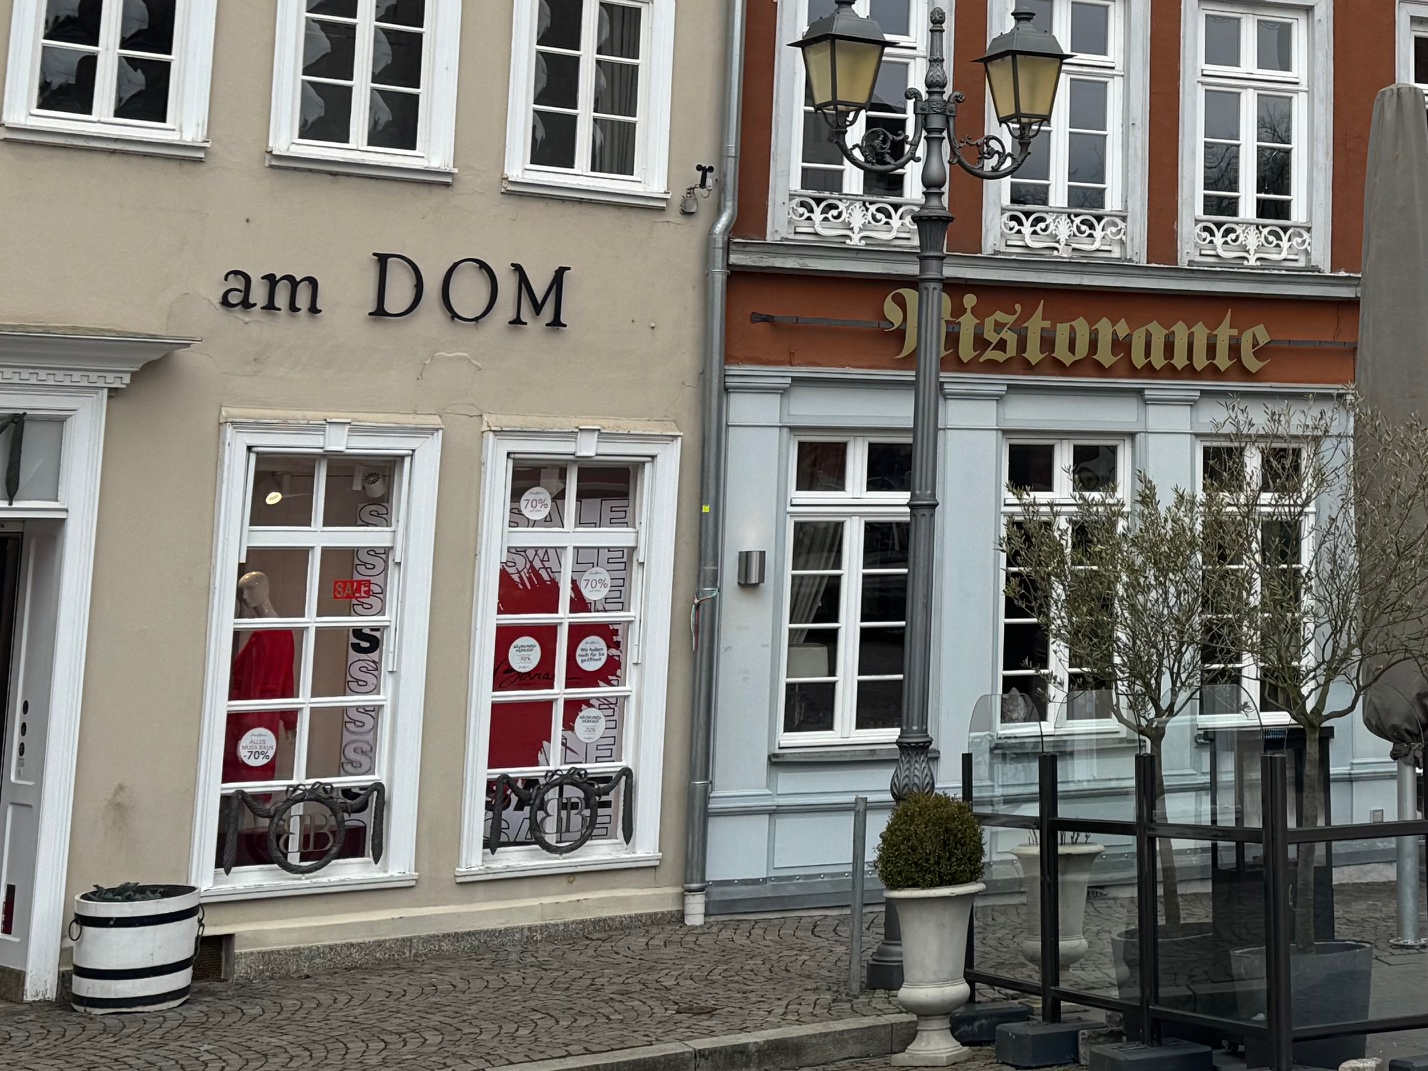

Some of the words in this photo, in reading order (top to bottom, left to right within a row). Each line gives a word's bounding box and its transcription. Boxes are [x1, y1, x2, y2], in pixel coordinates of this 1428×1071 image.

[220, 269, 323, 315] am
[368, 252, 572, 328] DOM
[883, 287, 1272, 374] Ristorante
[524, 498, 549, 509] 70%
[334, 582, 369, 597] SALE
[583, 578, 609, 589] 70%
[243, 750, 270, 760] -70%
